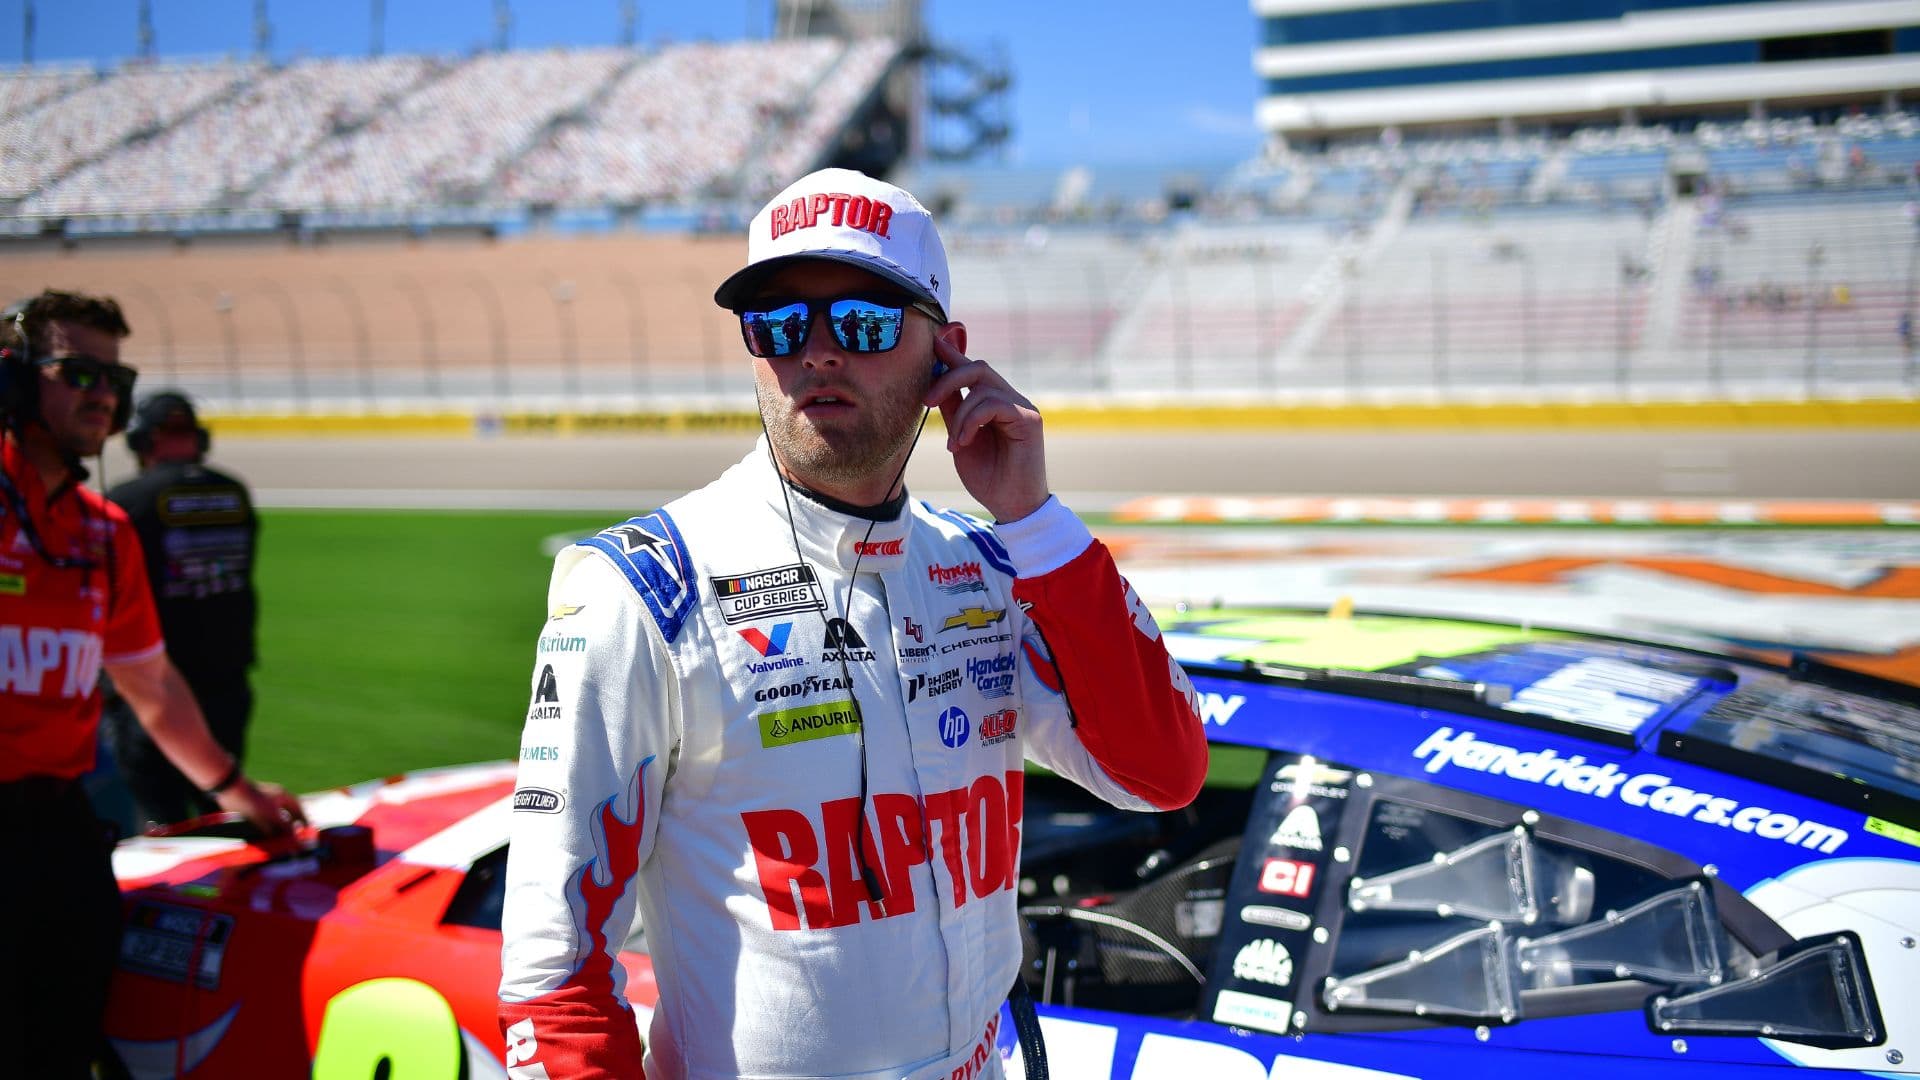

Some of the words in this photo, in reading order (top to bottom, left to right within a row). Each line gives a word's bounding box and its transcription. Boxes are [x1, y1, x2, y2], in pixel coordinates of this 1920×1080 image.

[771, 192, 893, 241] RAPTOR
[746, 569, 799, 592] NASCAR
[734, 594, 761, 612] CUP
[763, 588, 808, 606] SERIES
[899, 642, 937, 658] LIBERTY
[941, 633, 1014, 655] CHEVROET
[0, 624, 104, 700] APTO
[746, 657, 804, 674] Valvoline
[928, 676, 963, 698] ENERGY
[530, 706, 561, 719] XALTA
[791, 711, 857, 732] ANDURIL
